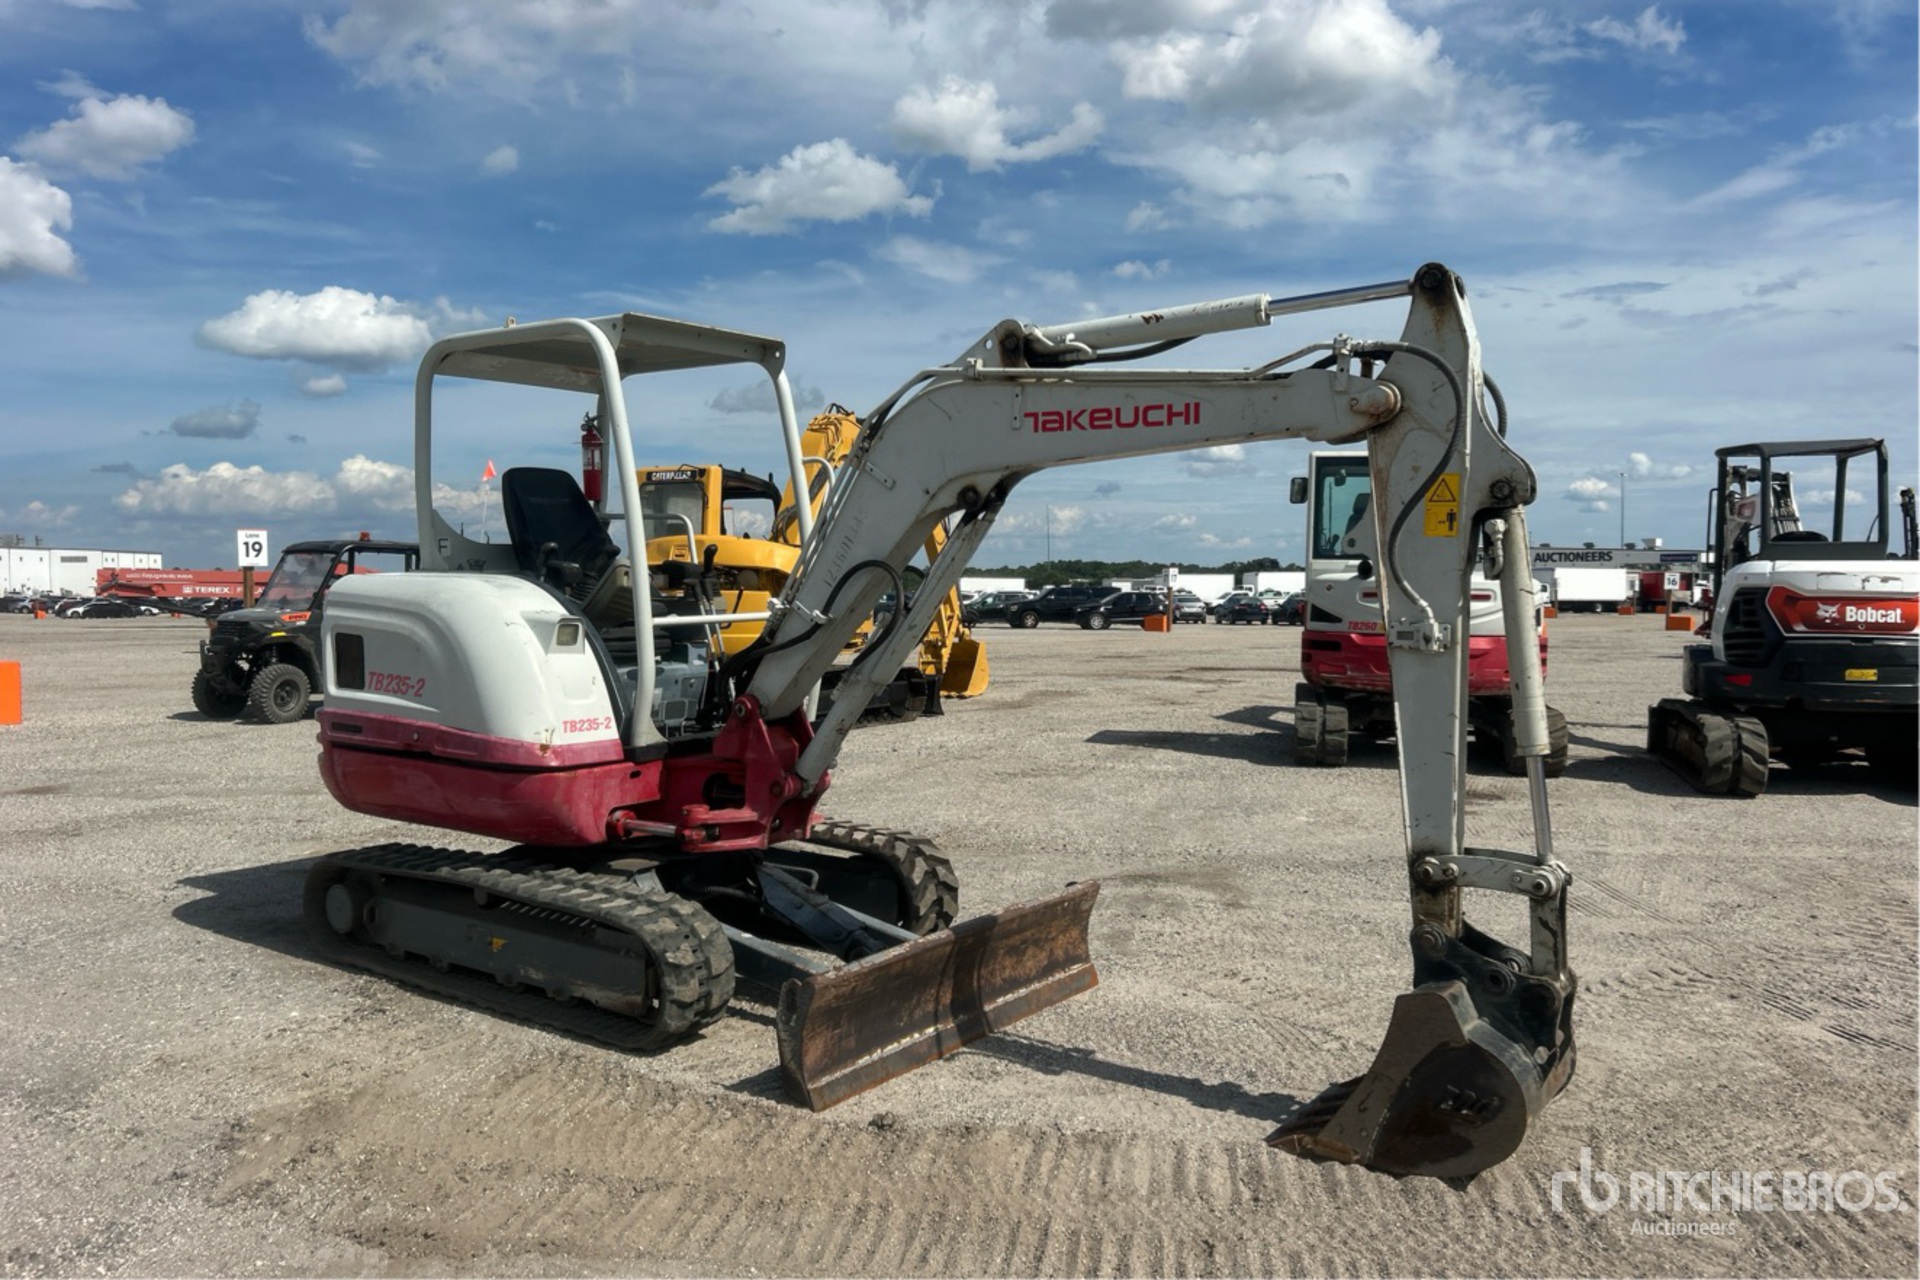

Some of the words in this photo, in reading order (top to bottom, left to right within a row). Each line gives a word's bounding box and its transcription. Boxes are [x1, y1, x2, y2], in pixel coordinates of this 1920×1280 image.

[1023, 402, 1201, 433] TAKEUCHI
[242, 541, 263, 558] 19
[1534, 551, 1613, 562] AUCTIONEERS
[194, 586, 230, 594] TEREX
[1666, 577, 1678, 586] 16
[1845, 606, 1902, 623] Bobcat
[1348, 621, 1378, 631] TB260
[367, 671, 426, 698] TB235-2
[562, 716, 612, 734] TB235-2
